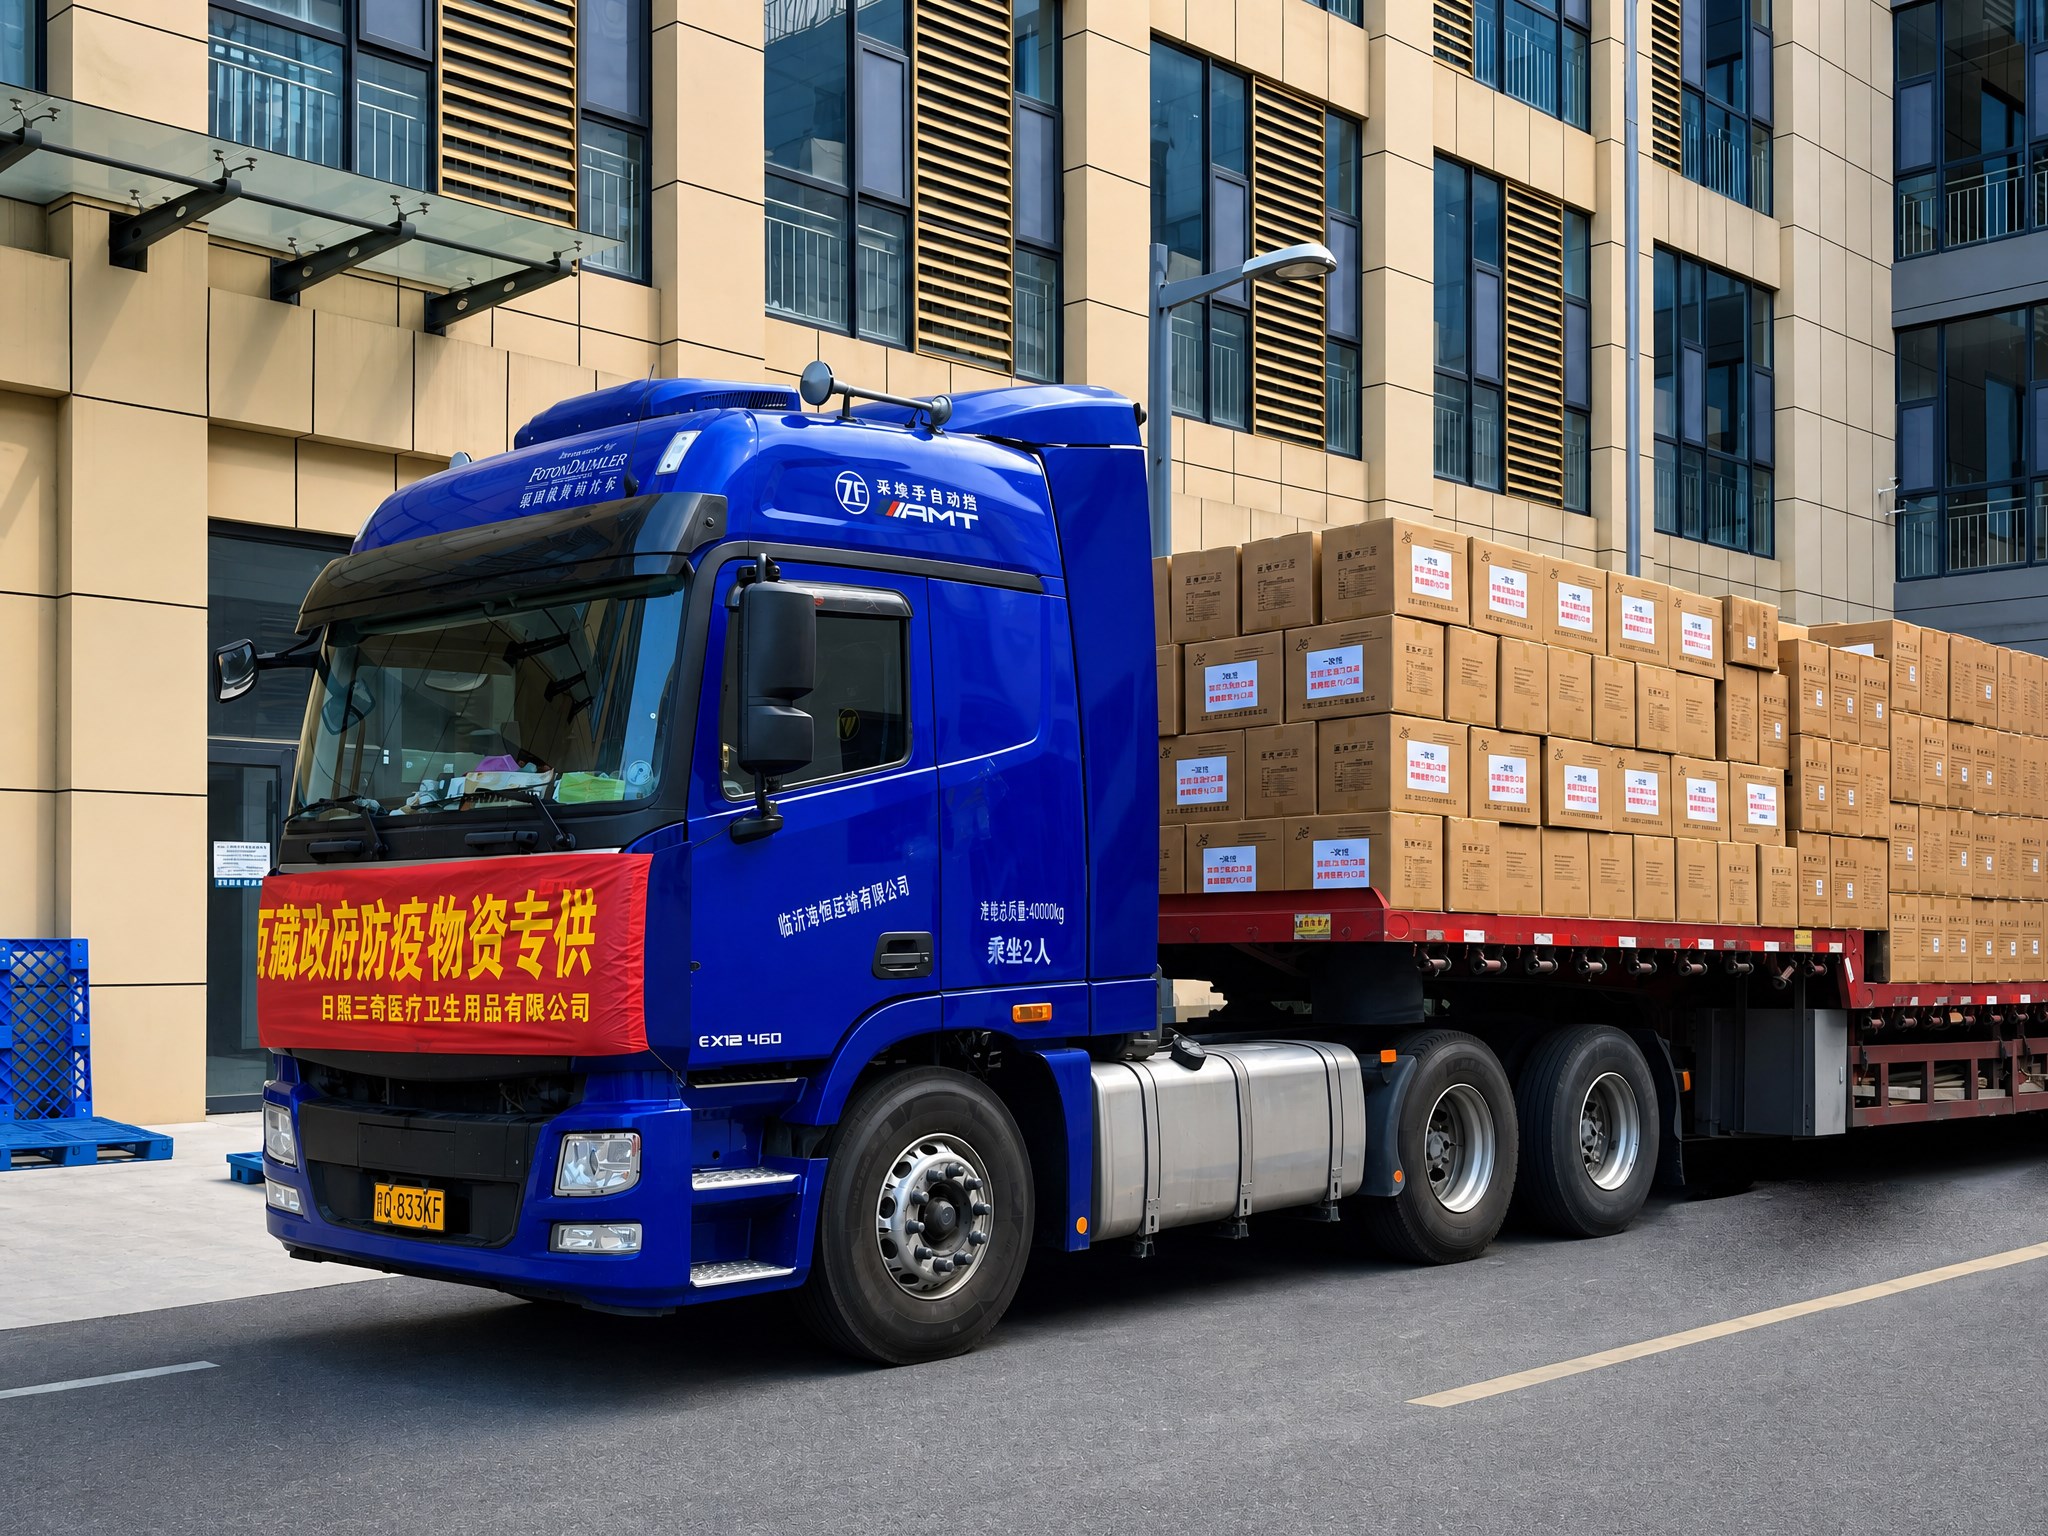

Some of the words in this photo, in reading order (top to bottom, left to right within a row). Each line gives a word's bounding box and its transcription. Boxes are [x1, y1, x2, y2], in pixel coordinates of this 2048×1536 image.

[836, 475, 868, 510] ZF
[901, 502, 979, 529] AMT
[777, 874, 910, 938] 临沂海恒运输有限公司
[257, 888, 597, 981] 西藏政府防疫物资专供
[987, 935, 1052, 966] 乘坐2人
[321, 992, 590, 1024] 日照三奇医疗卫生用品有限公司
[698, 1034, 743, 1048] EX12
[747, 1032, 782, 1046] 460
